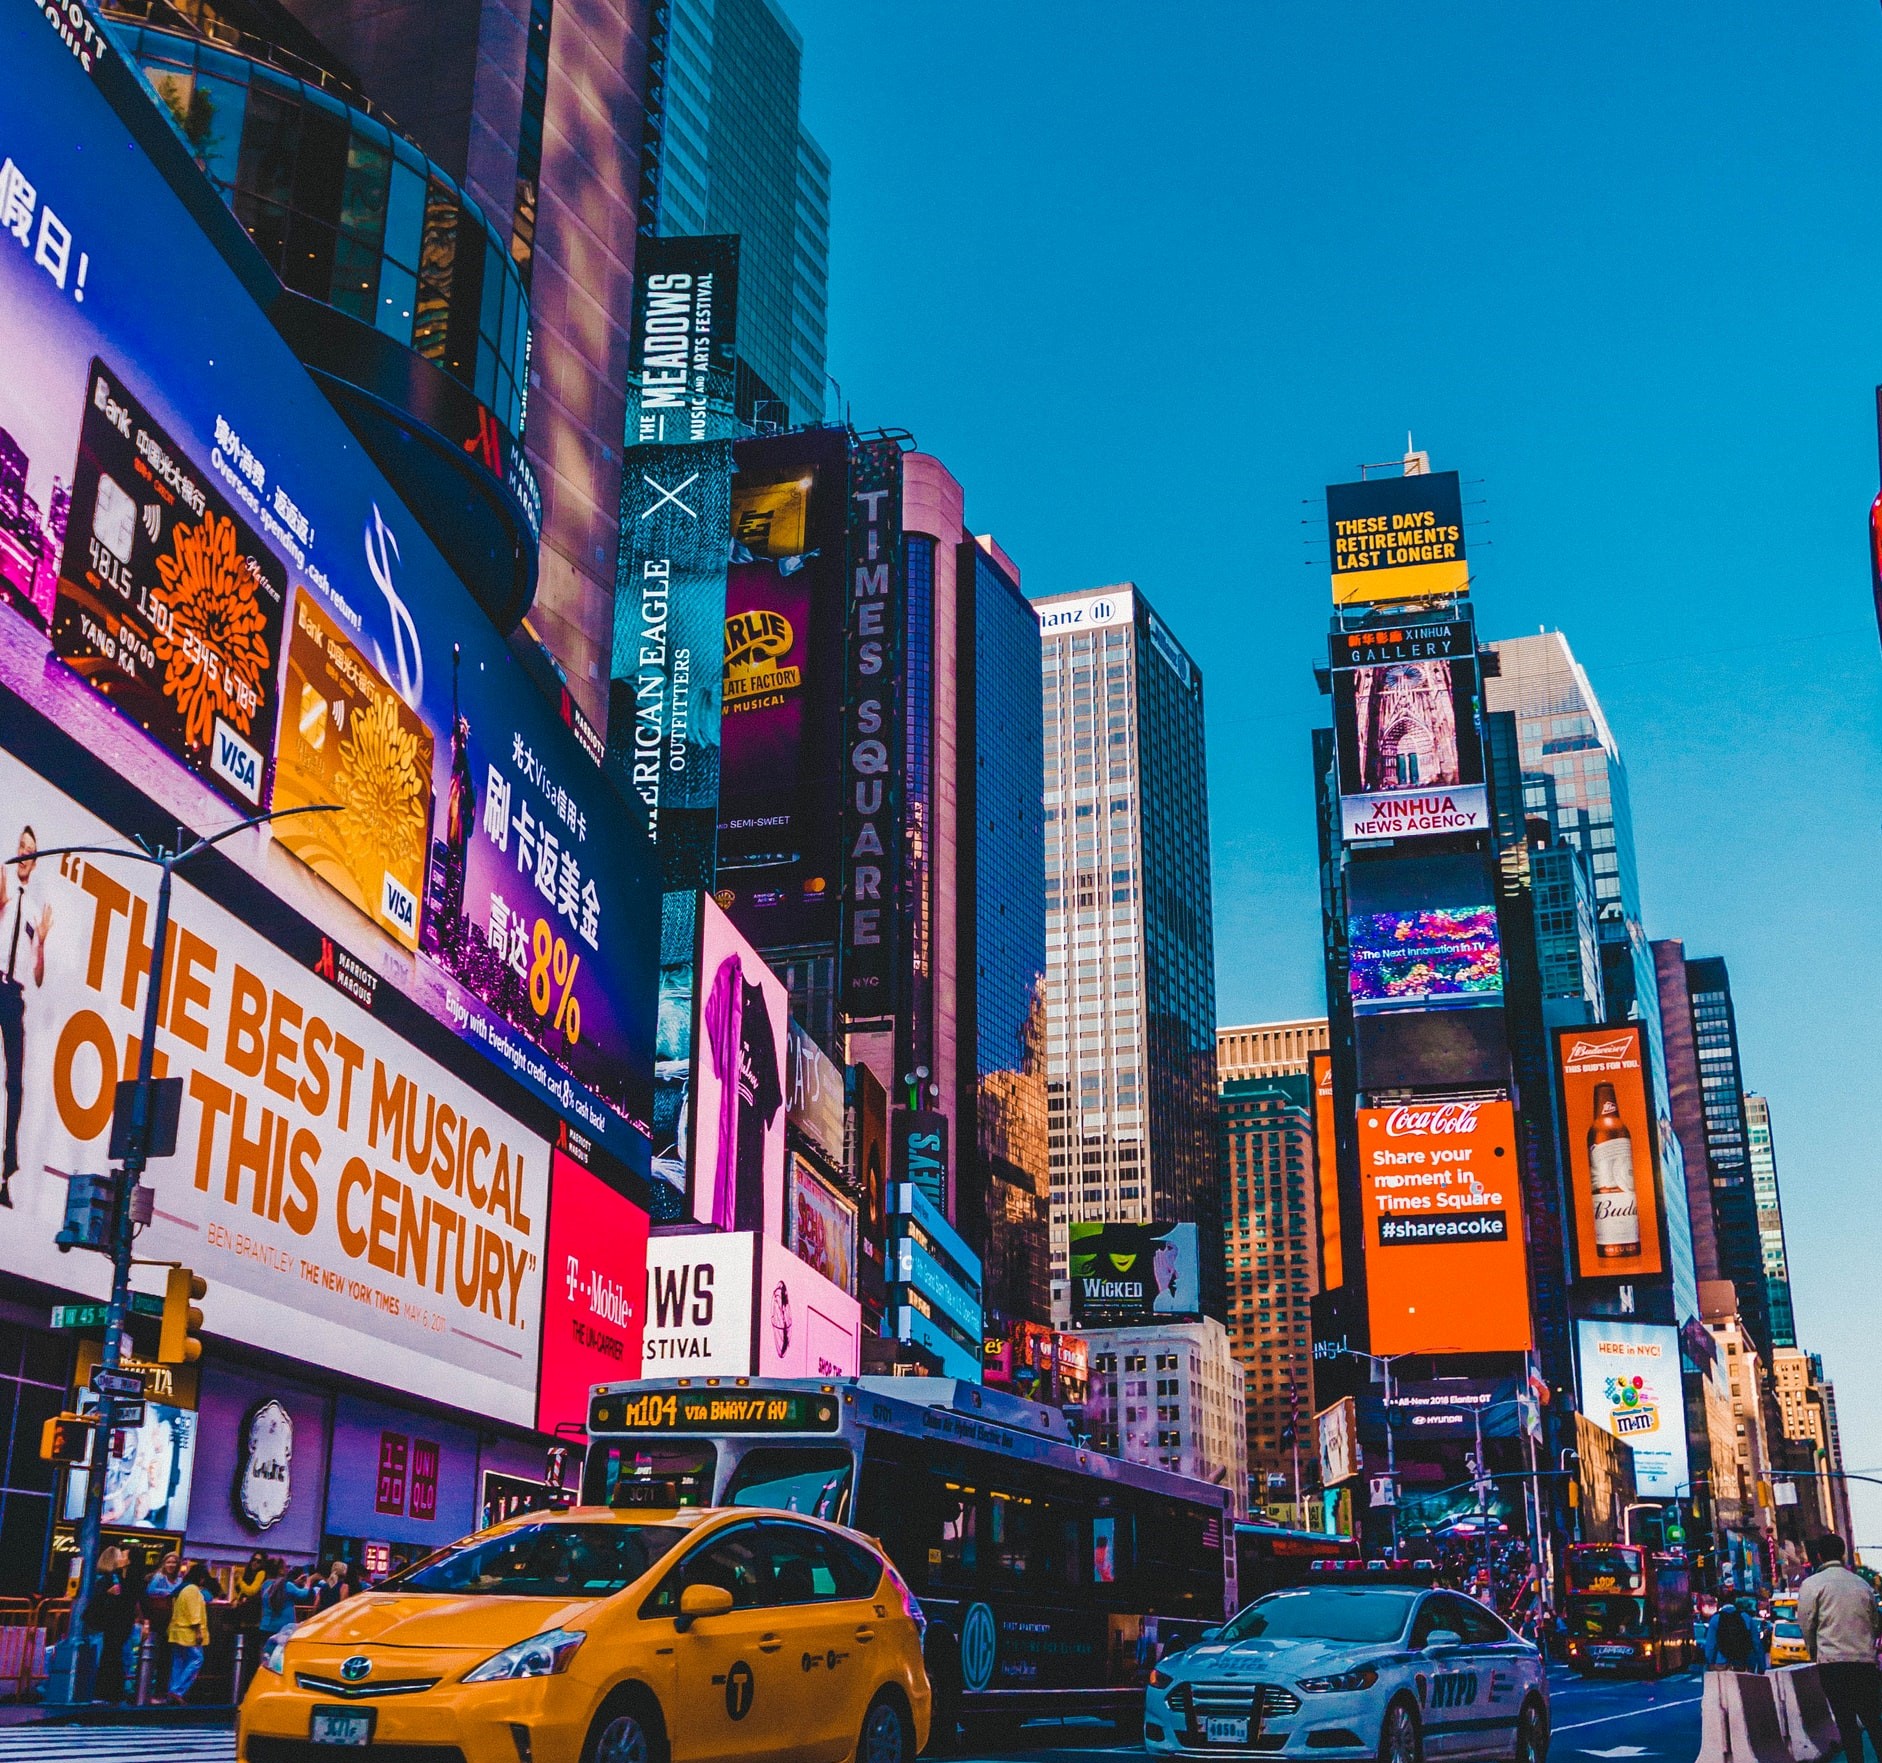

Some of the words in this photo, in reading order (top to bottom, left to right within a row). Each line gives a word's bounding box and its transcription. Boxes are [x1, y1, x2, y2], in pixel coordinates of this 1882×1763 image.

[695, 272, 713, 333] FESTIVAL
[641, 273, 692, 408] MEADOWS
[693, 337, 710, 371] ARTS
[695, 375, 705, 393] AND
[94, 376, 132, 439] Bank
[690, 397, 707, 440] MUSIC
[639, 414, 656, 442] THE
[211, 447, 260, 514] Overseas
[260, 507, 306, 570] spending
[1335, 516, 1388, 536] THESE
[1393, 510, 1435, 530] DAYS
[1336, 525, 1459, 553] RETIREMENTS
[1337, 551, 1380, 570] LAST
[1387, 542, 1456, 565] LONGER
[856, 490, 888, 676] TIMES
[640, 558, 671, 667] EAGLE
[80, 613, 117, 659] YANG
[118, 649, 137, 678] KA
[1405, 625, 1452, 641] XINHUA
[1352, 640, 1452, 662] GALLERY
[750, 669, 797, 692] FACTORY
[669, 647, 691, 772] OUTFITTERS
[733, 695, 785, 714] MUSICAL
[219, 731, 257, 791] VISA
[730, 815, 791, 829] SEMI-SWEET
[852, 699, 888, 946] SQUARE
[1371, 796, 1457, 820] XINHUA
[1354, 819, 1403, 836] NEWS
[1406, 812, 1478, 831] AGENCY
[386, 880, 413, 928] VISA
[1361, 949, 1382, 961] The
[1382, 947, 1407, 959] Next
[1407, 943, 1459, 957] Innovation
[1460, 942, 1470, 953] in
[1472, 941, 1486, 952] TV
[339, 953, 378, 990] MARRIOTT
[337, 970, 372, 1005] MARQUIS
[445, 989, 470, 1030] Enjoy
[469, 1014, 488, 1040] with
[488, 1025, 527, 1072] Everbright
[526, 1059, 548, 1087] credit
[574, 1098, 591, 1123] cash
[1574, 1042, 1626, 1057] Budweiser
[1564, 1061, 1581, 1073] THIS
[1582, 1062, 1605, 1072] BUD'S
[1606, 1062, 1622, 1071] FOR
[225, 963, 364, 1133] BEST
[367, 1057, 531, 1236] MUSICAL
[189, 1069, 321, 1236] THIS
[1373, 1150, 1426, 1166] Share
[1431, 1147, 1473, 1164] your
[1374, 1172, 1452, 1189] moment
[1457, 1169, 1475, 1184] in
[1376, 1195, 1431, 1211] Times
[1436, 1190, 1503, 1211] Square
[1382, 1217, 1504, 1238] #shareacoke
[207, 1222, 233, 1251] BEN
[235, 1233, 295, 1274] BRANTLEY
[299, 1260, 320, 1285] THE
[322, 1269, 345, 1295] NEW
[347, 1279, 372, 1306] YORK
[374, 1290, 400, 1317] TIMES
[79, 1307, 95, 1324] 45
[572, 1319, 586, 1345] THE
[586, 1325, 624, 1361] UN-CARRIER
[1598, 1343, 1625, 1354] HERE
[1626, 1346, 1636, 1355] in
[1637, 1346, 1661, 1357] NYC!
[817, 1357, 831, 1375] SHOP
[626, 1395, 677, 1426] M104
[710, 1401, 765, 1420] BWAY/7
[767, 1401, 788, 1420] AV
[1450, 1395, 1479, 1404] Elantra
[1480, 1393, 1492, 1403] GT
[1426, 1414, 1463, 1424] HYUNDAI
[415, 1448, 435, 1479] UNI
[413, 1481, 435, 1514] QLO
[1433, 1673, 1478, 1708] NYPD
